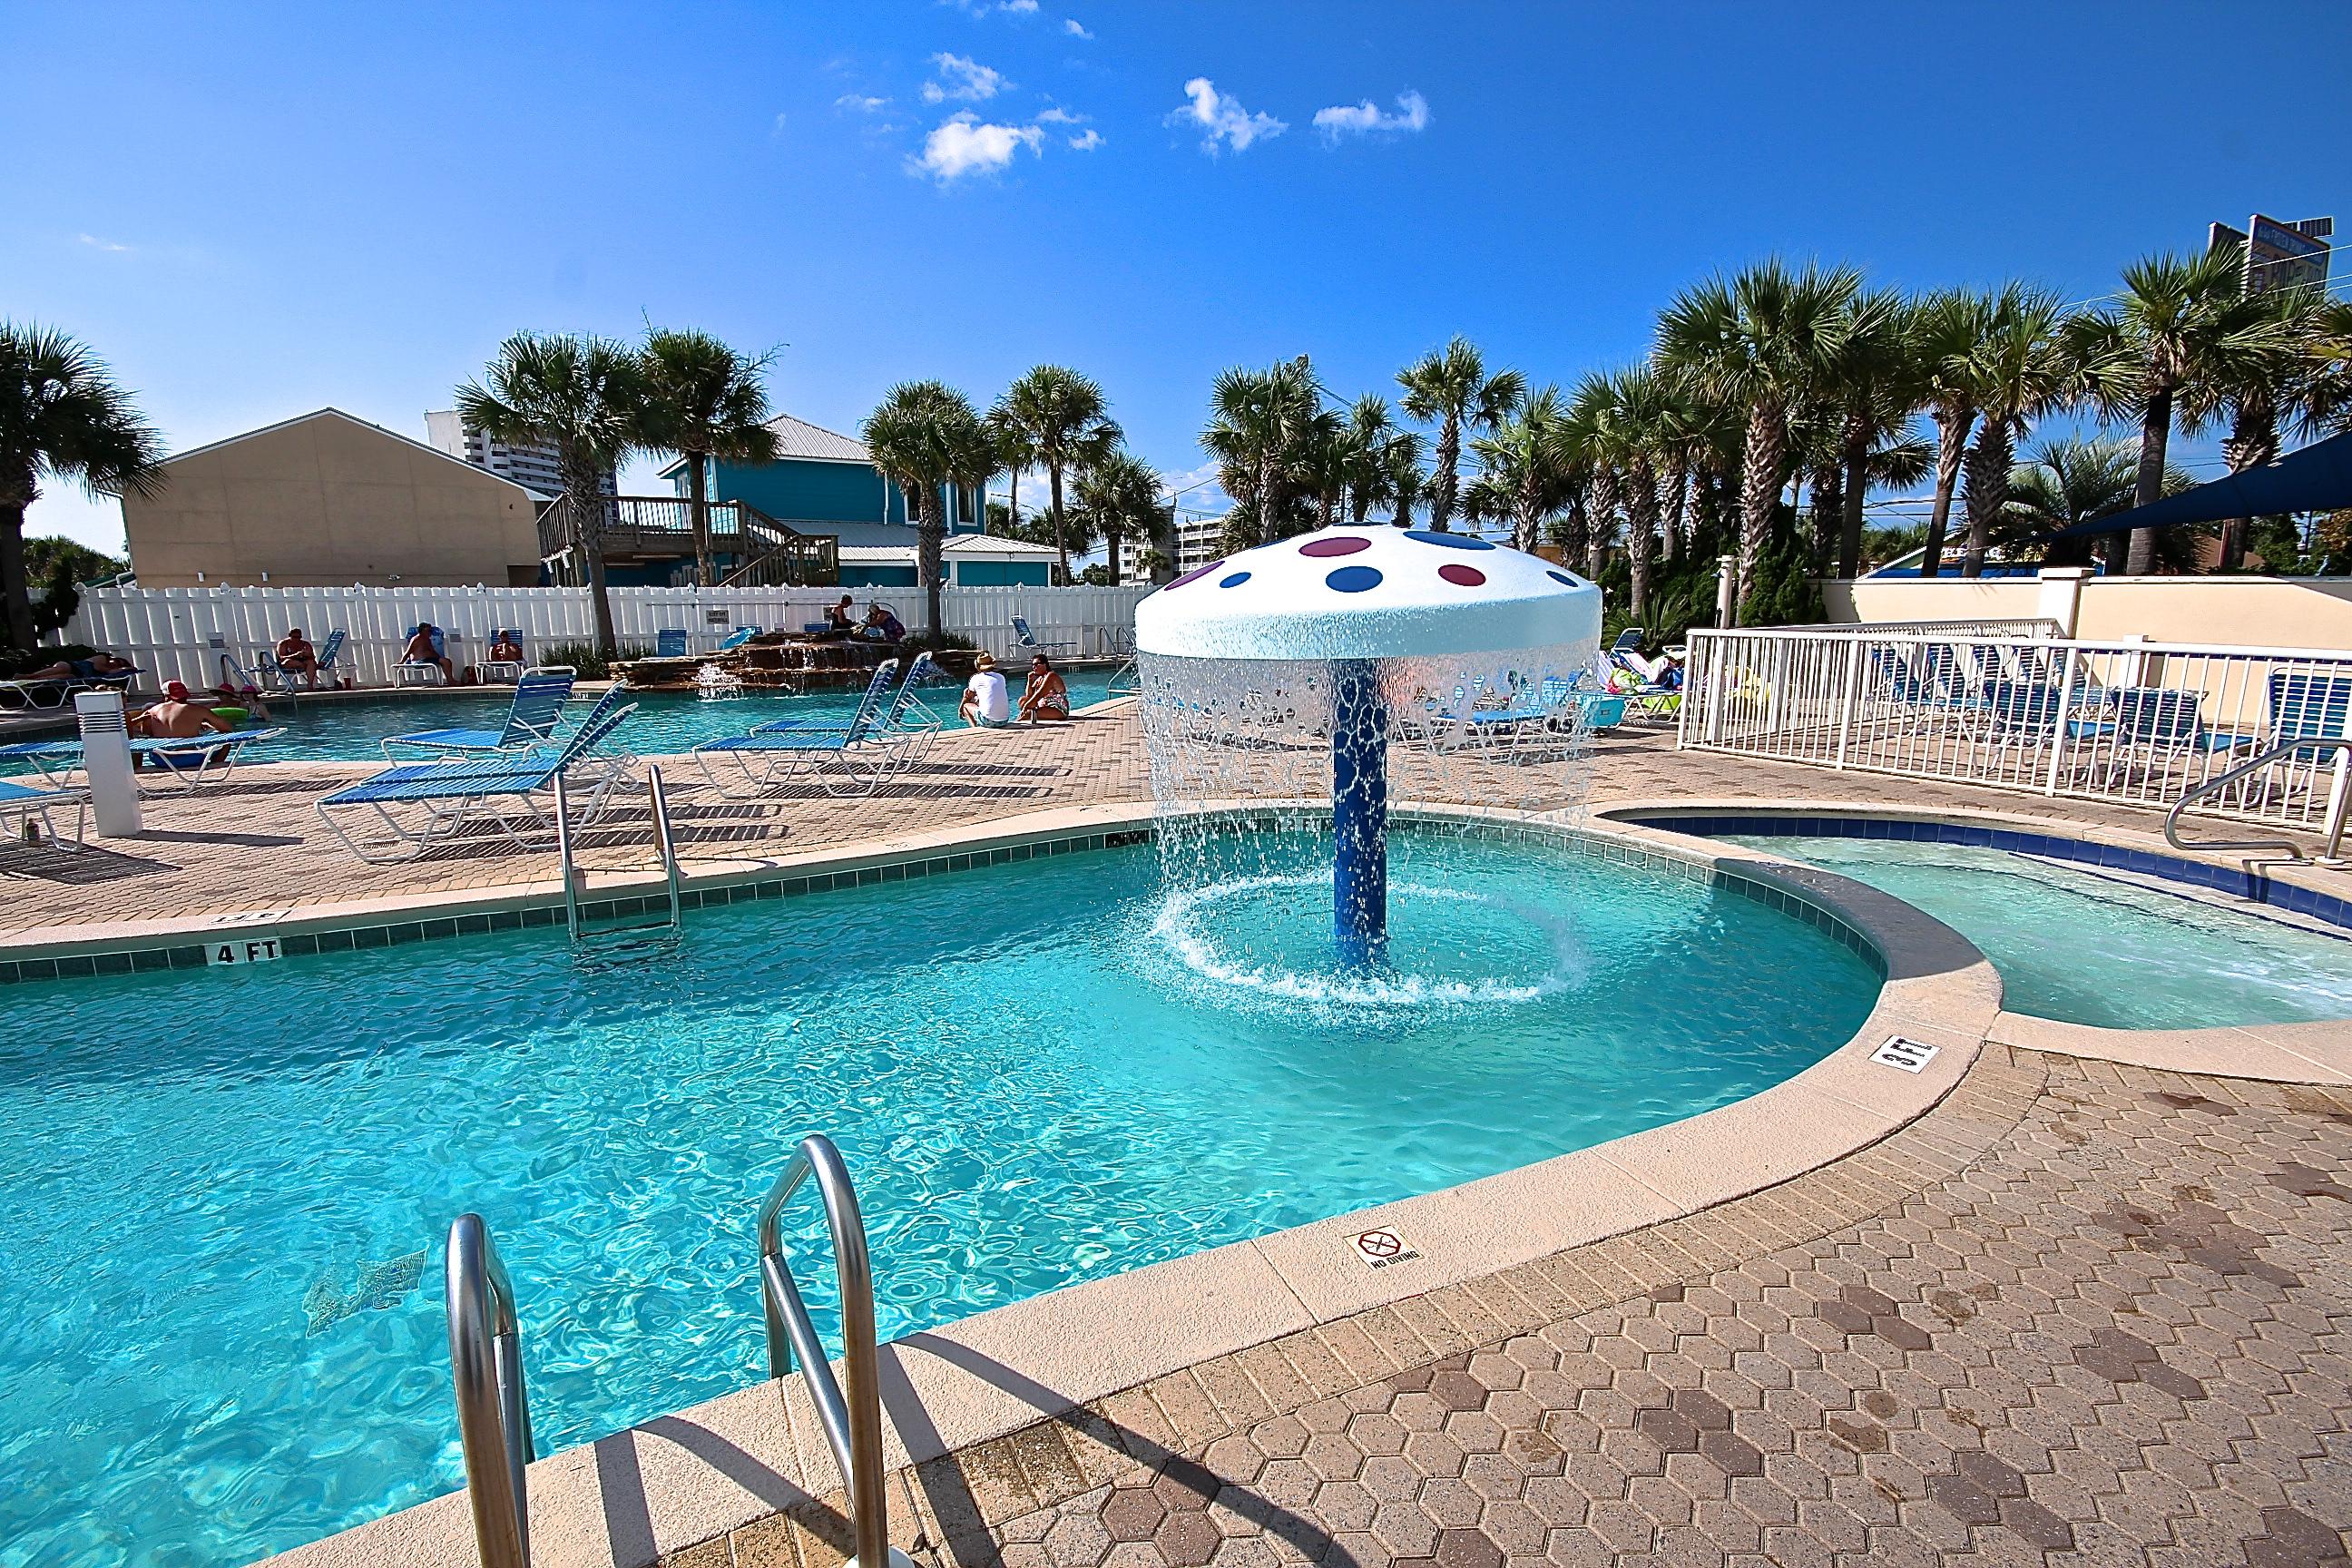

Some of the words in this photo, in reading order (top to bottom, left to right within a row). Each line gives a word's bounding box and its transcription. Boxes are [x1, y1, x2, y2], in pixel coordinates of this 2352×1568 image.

[218, 944, 235, 963] 4
[1881, 1053, 1917, 1066] 3
[1370, 1259, 1387, 1269] NO
[1387, 1250, 1420, 1265] DIVING
